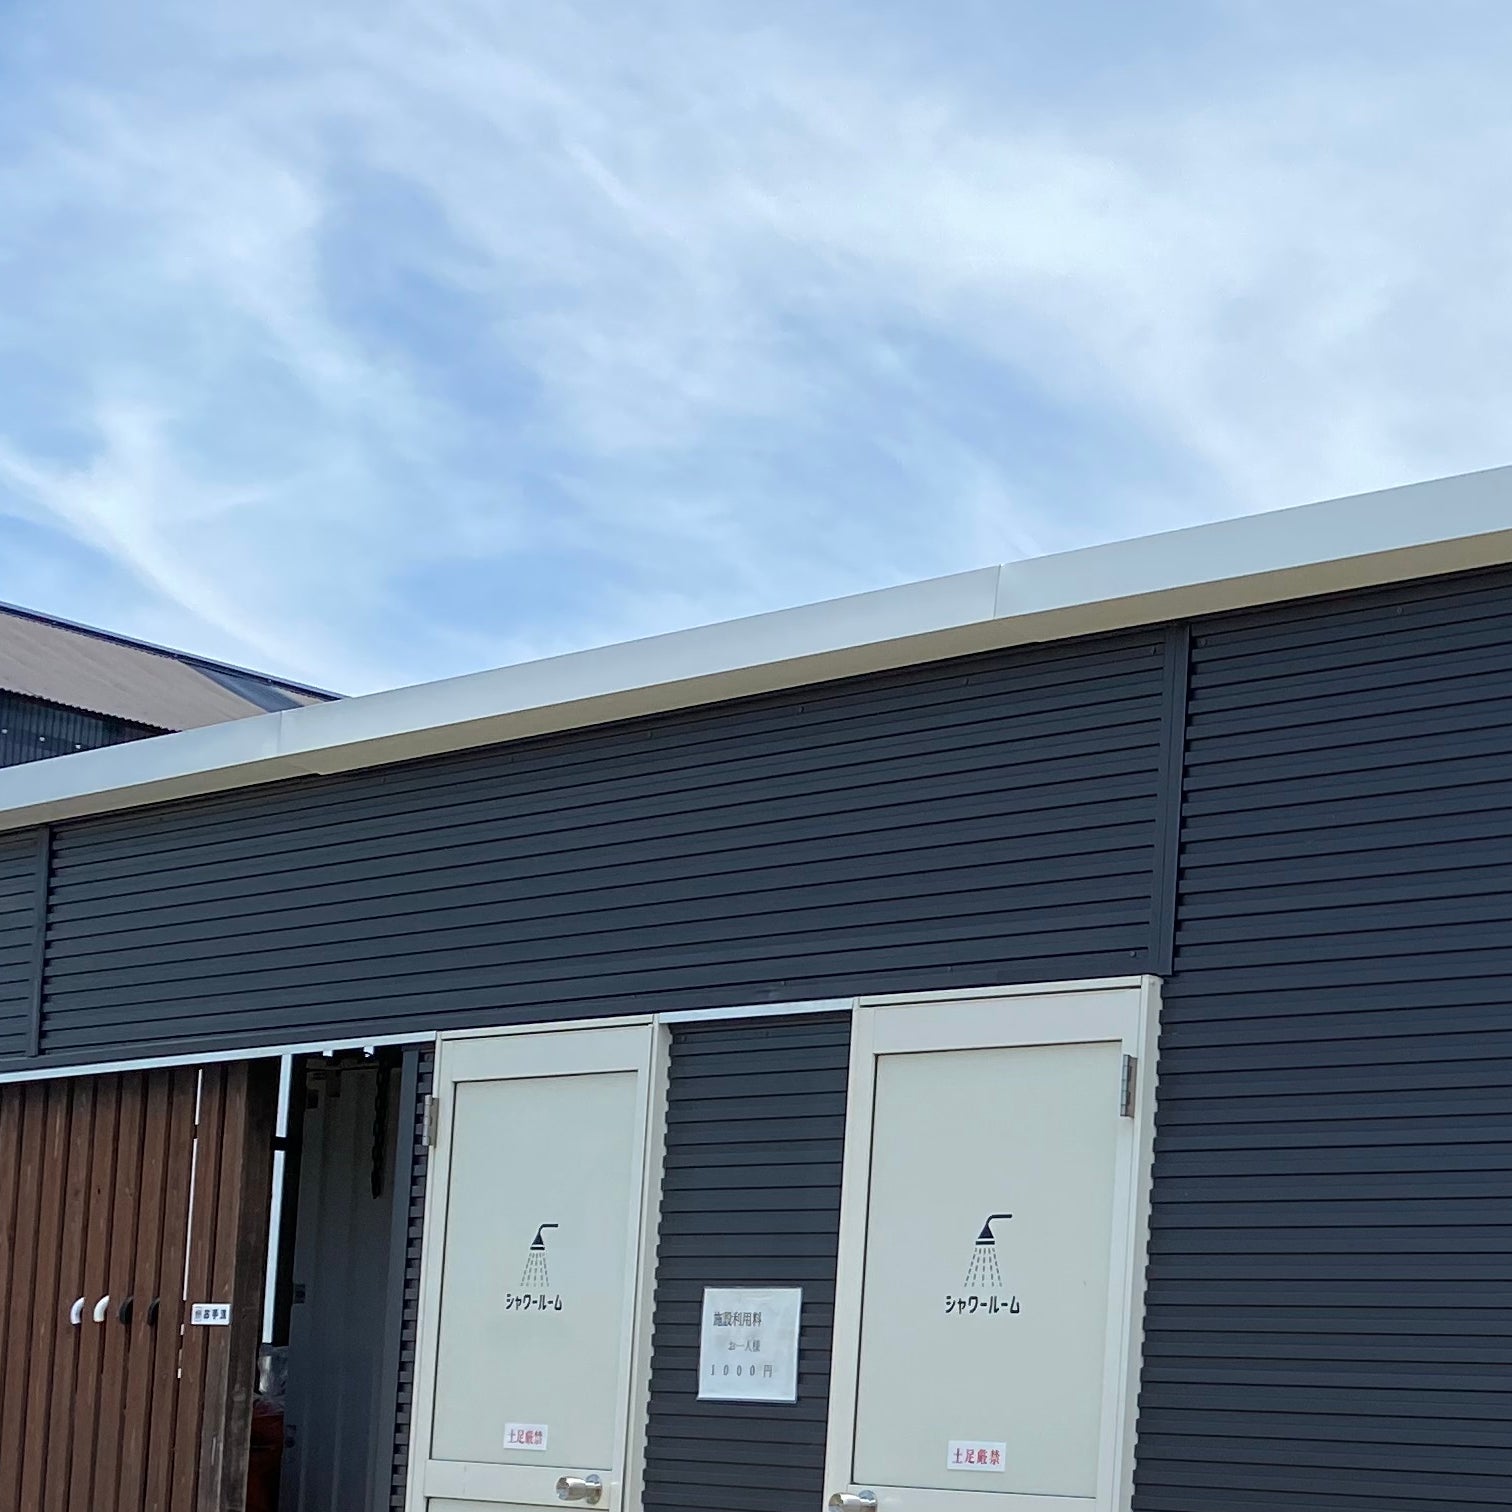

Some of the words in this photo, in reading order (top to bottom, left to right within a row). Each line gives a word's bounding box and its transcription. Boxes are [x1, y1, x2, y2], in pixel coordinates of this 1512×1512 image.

[505, 1293, 562, 1311] シャワールーム
[945, 1296, 1020, 1314] シャワールーム
[713, 1312, 762, 1327] 施設利用料
